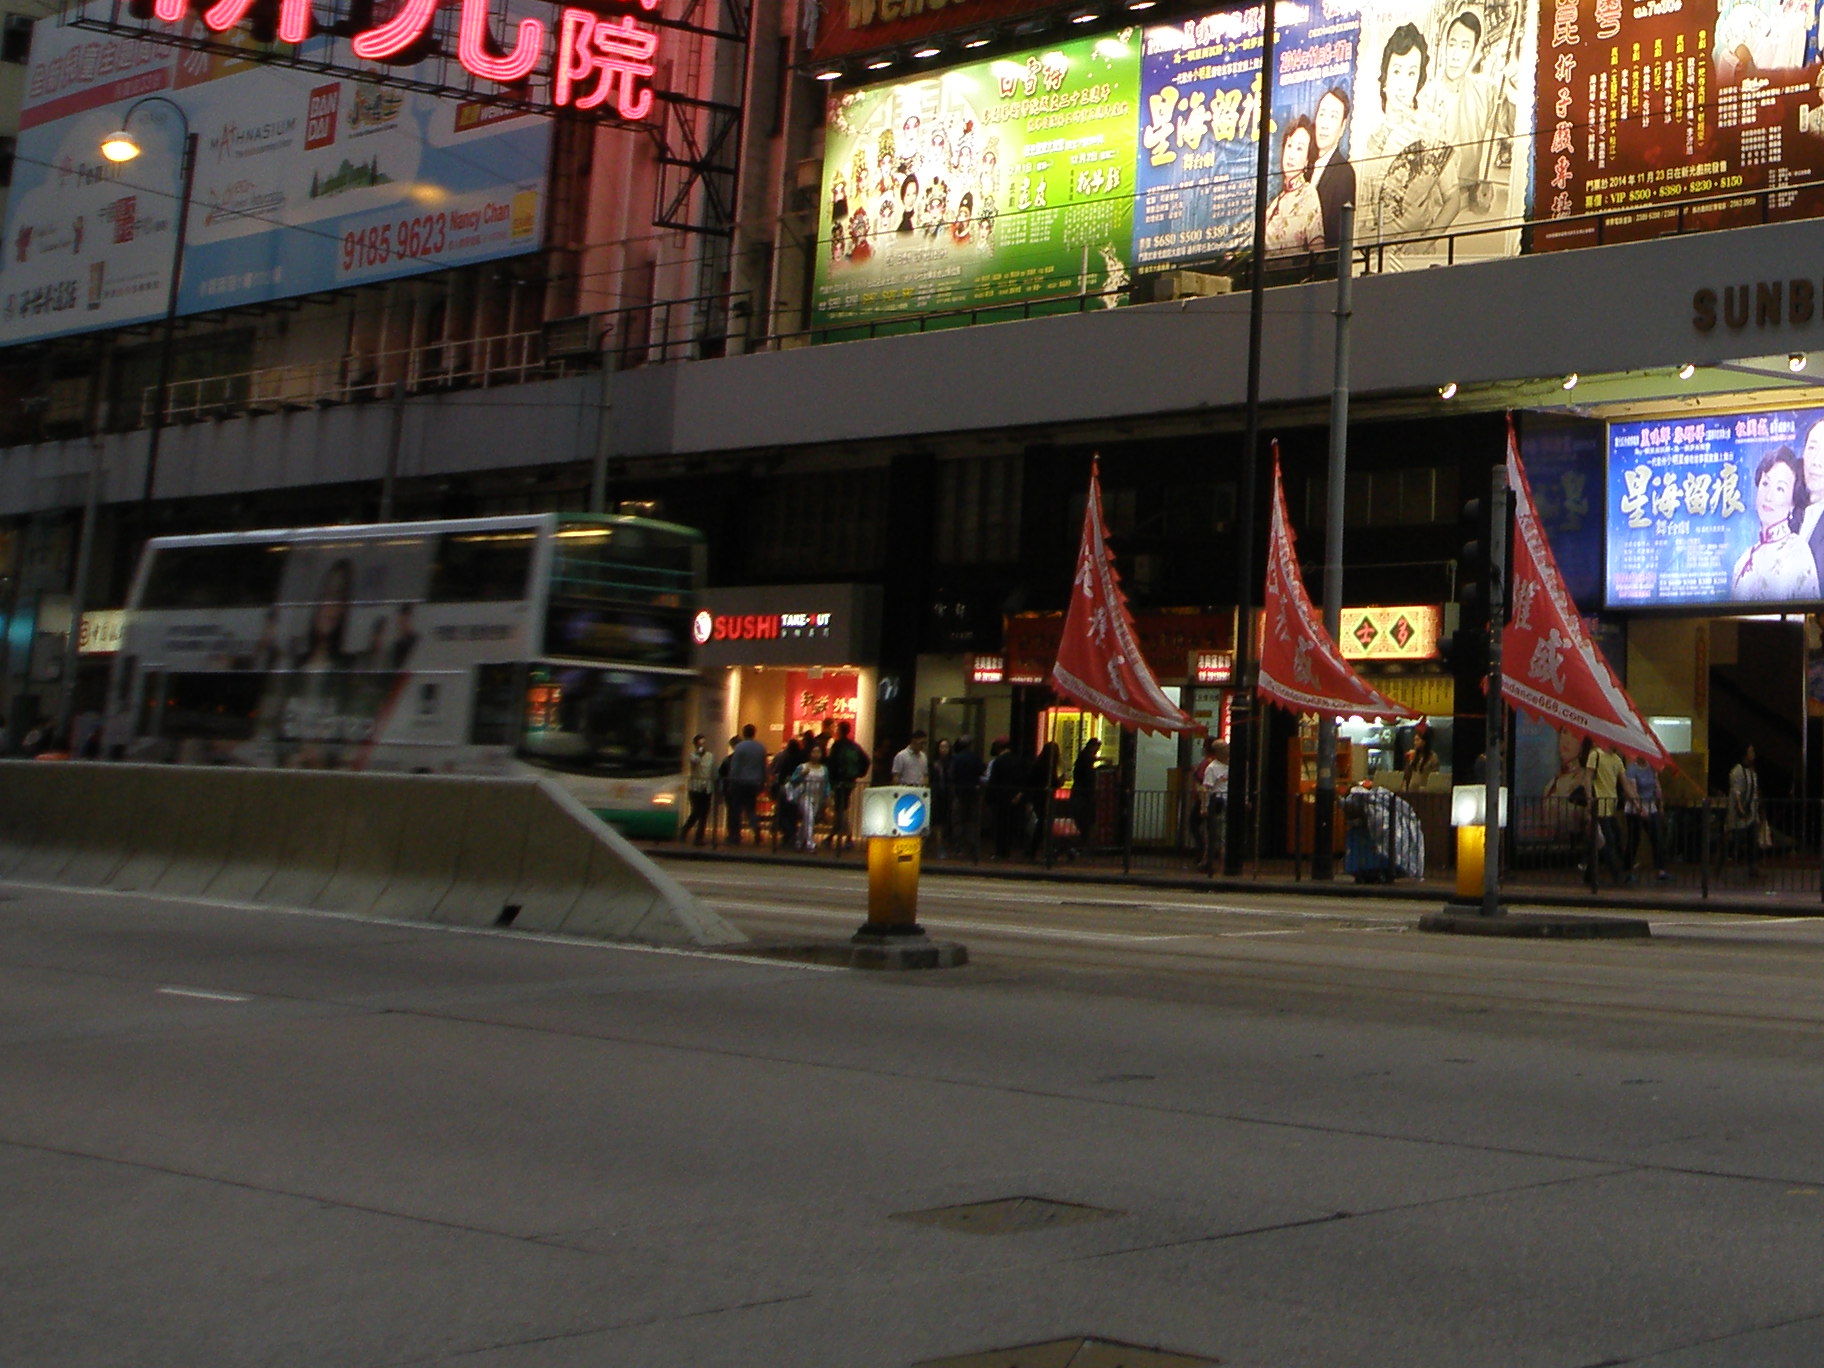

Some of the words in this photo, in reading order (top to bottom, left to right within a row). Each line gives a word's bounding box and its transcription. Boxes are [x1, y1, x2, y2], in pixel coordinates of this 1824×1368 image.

[210, 118, 298, 163] MATHNASIUM
[1610, 192, 1627, 205] VIP
[1629, 187, 1651, 202] $500
[1659, 183, 1681, 197] $380
[449, 209, 481, 232] Nancy
[483, 203, 511, 224] Chan
[342, 224, 392, 272] 9185
[397, 213, 448, 261] 9623
[1620, 462, 1746, 529] 星海留痕
[714, 615, 778, 640] SUSHI
[1356, 617, 1408, 647] 士多
